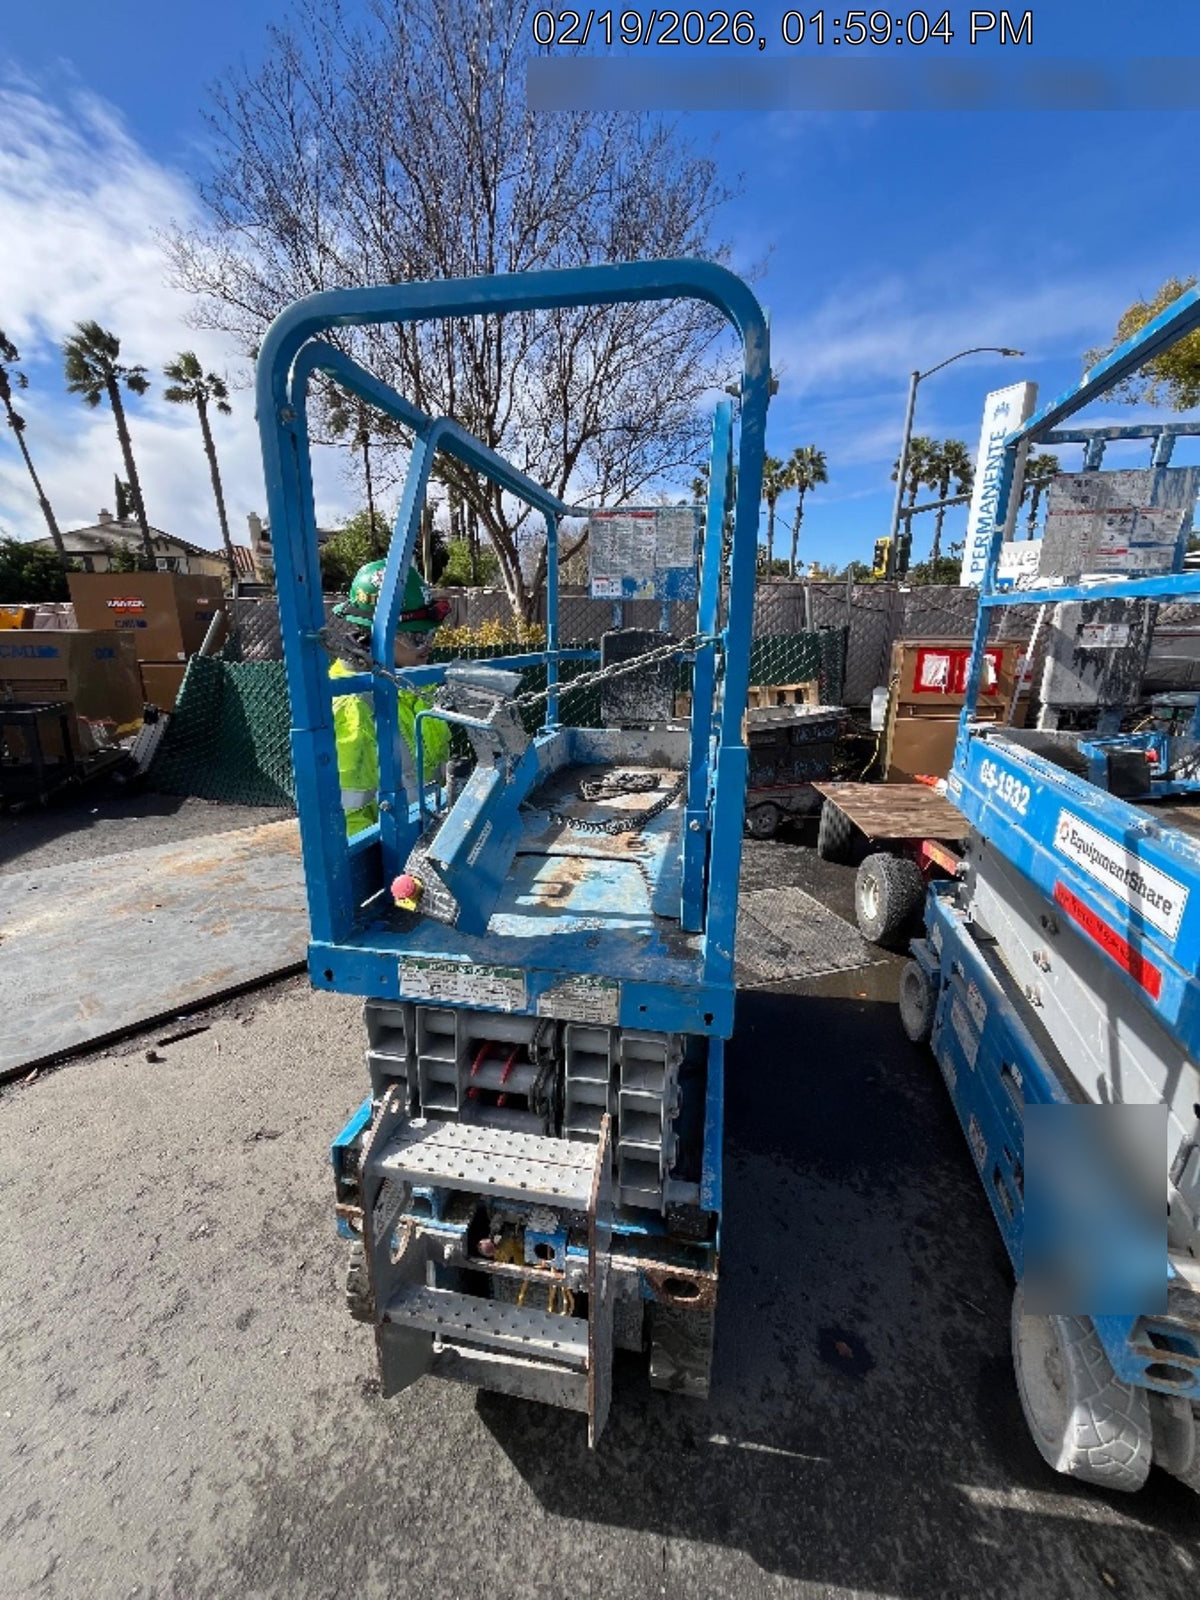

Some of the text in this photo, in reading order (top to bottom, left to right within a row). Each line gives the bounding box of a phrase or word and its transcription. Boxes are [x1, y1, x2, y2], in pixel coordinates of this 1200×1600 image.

[970, 427, 1008, 571] PERMANENTE
[980, 758, 1031, 816] GS-1932
[1069, 829, 1174, 916] EquipmentShare
